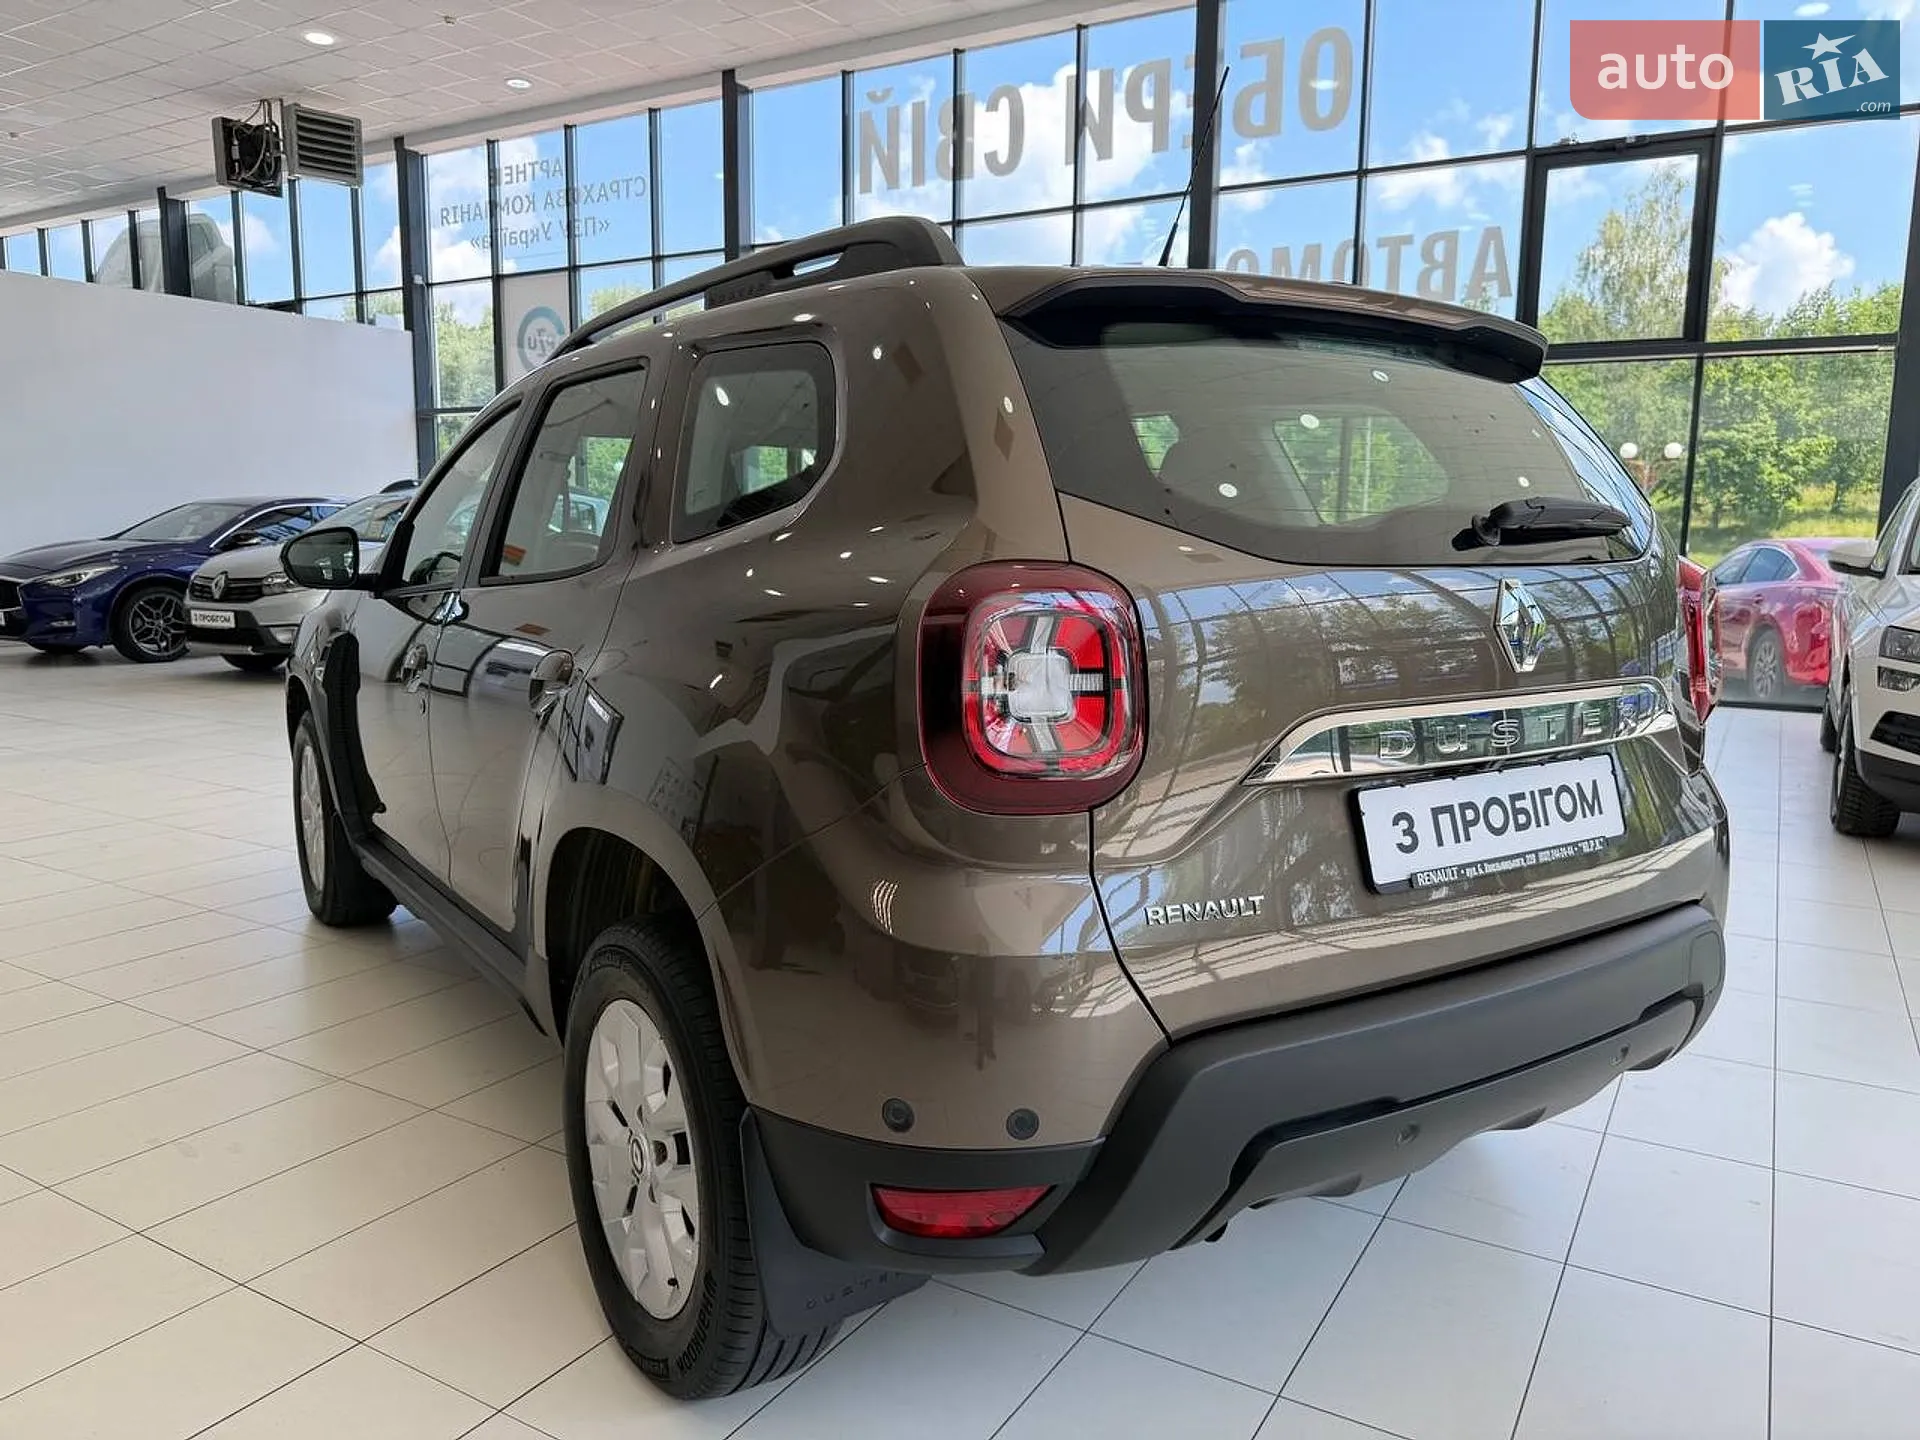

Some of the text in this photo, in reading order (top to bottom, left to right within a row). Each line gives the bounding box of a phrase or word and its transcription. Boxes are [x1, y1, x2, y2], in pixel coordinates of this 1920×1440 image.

[1378, 702, 1637, 759] DUSTER
[1430, 778, 1604, 848] ПРОБІГОМ
[1416, 866, 1459, 887] RENAULT
[1145, 893, 1265, 928] RENAULT
